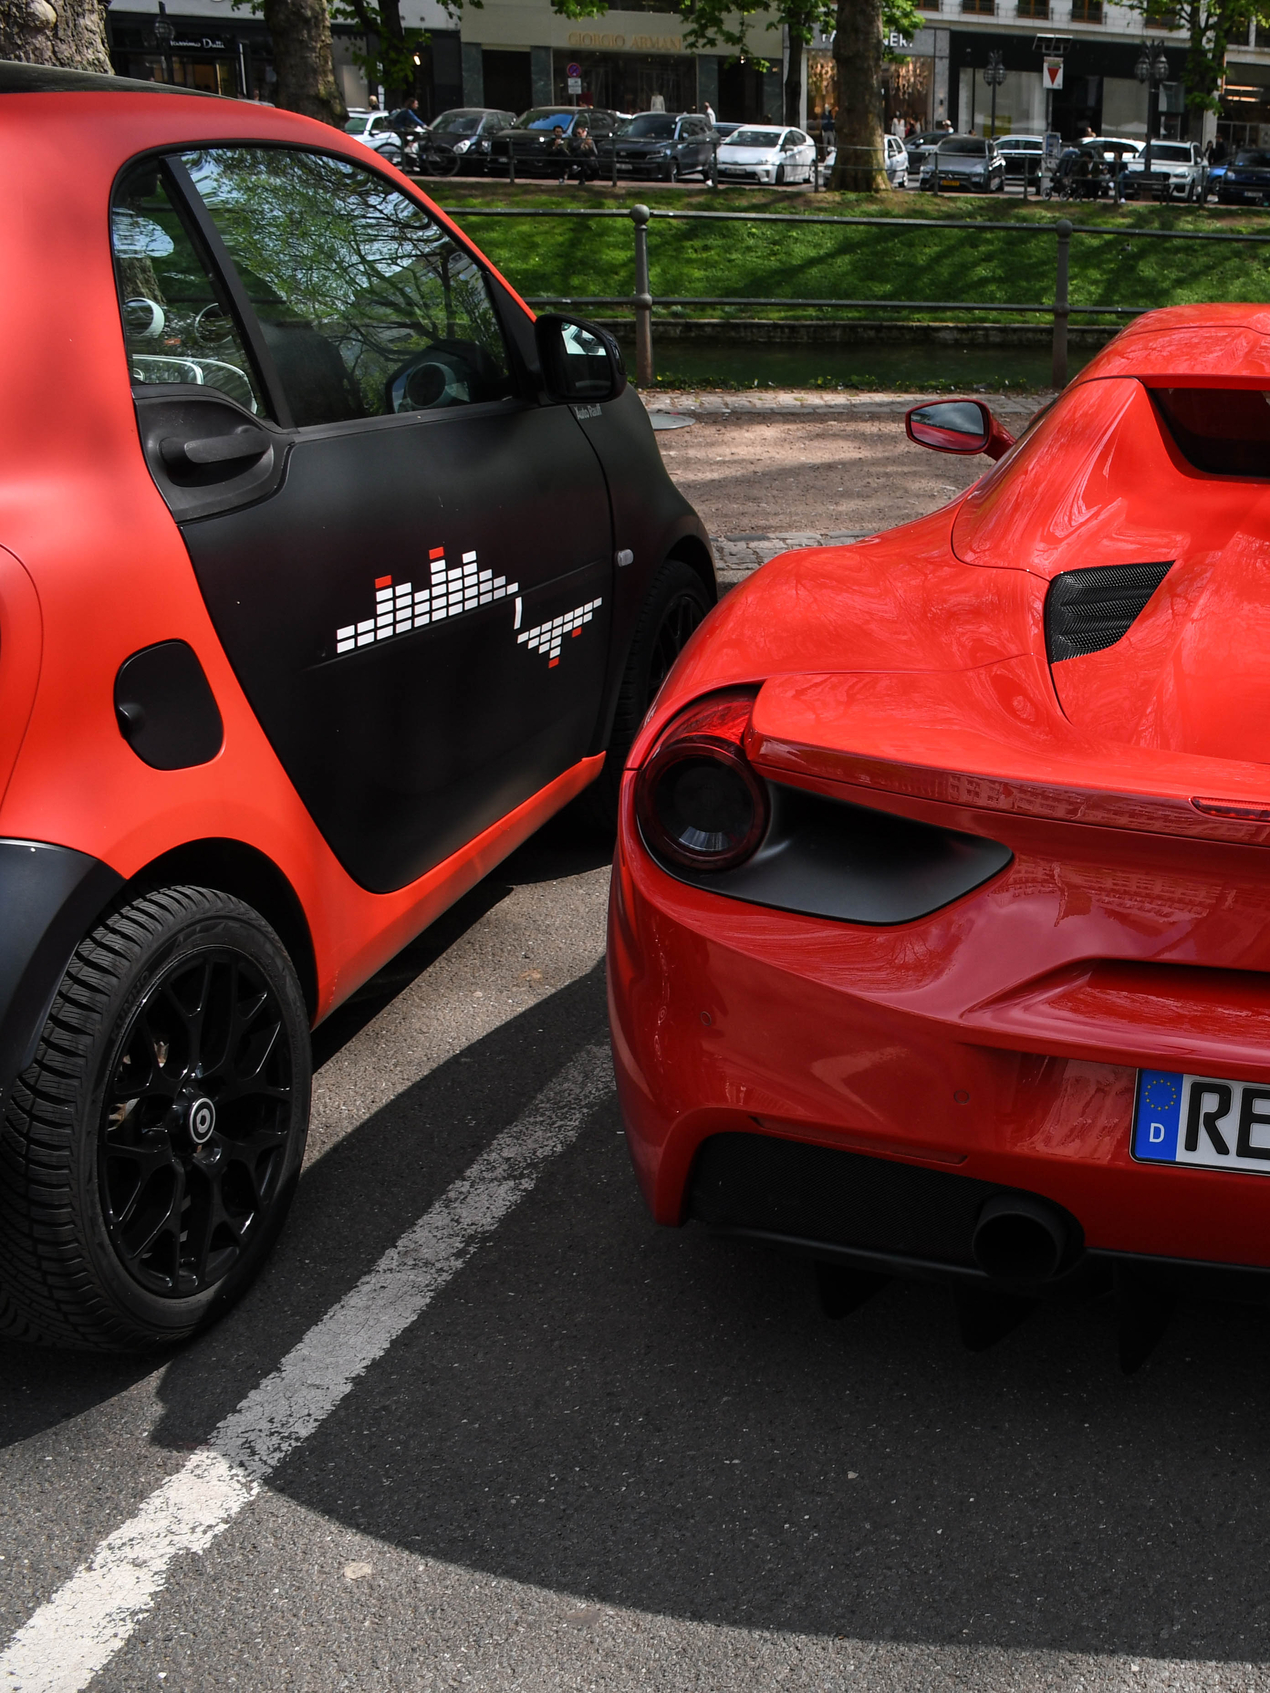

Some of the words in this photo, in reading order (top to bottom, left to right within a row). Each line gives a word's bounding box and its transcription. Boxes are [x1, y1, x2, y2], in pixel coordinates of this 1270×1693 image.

[170, 40, 201, 48] assimo
[202, 38, 226, 49] Dutti
[568, 31, 625, 47] GIORGIO
[629, 35, 681, 51] ARMANI
[1149, 1122, 1165, 1143] D
